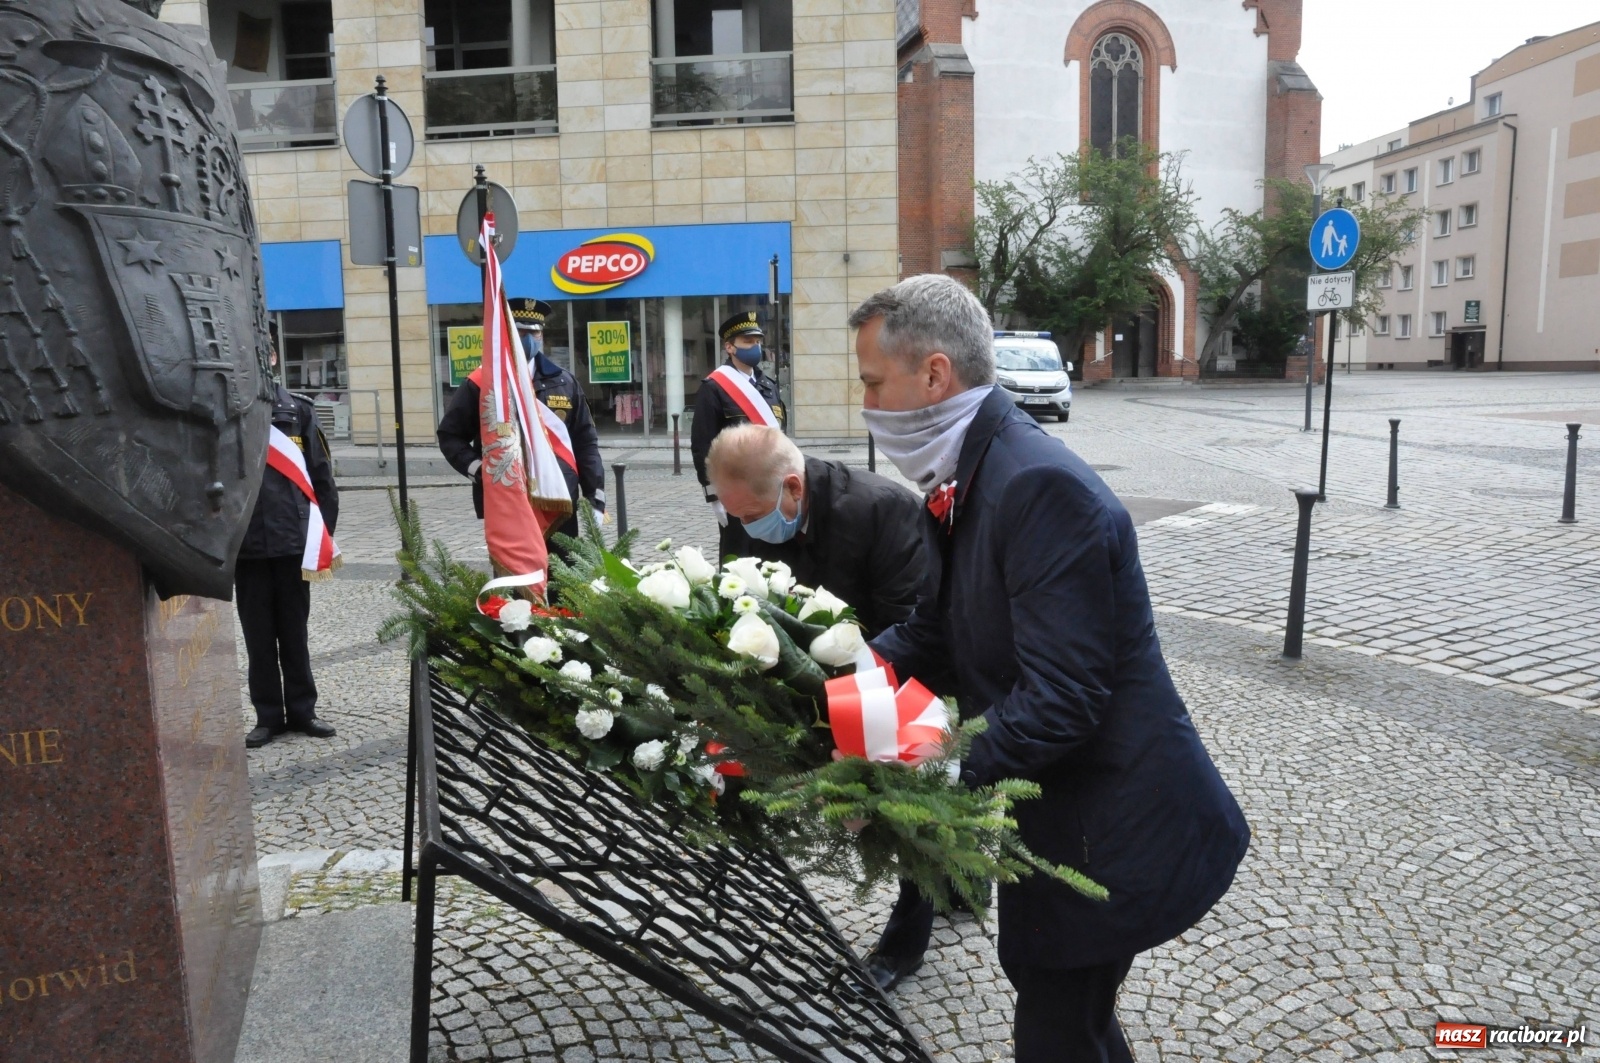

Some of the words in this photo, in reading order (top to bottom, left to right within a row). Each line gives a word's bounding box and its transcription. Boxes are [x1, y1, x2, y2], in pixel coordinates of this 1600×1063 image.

[567, 253, 638, 274] PEPCO
[1310, 277, 1322, 285] Nie
[1324, 275, 1352, 284] dotyczy
[450, 334, 483, 350] -30%
[590, 329, 626, 345] -30%
[454, 360, 465, 371] NA
[594, 356, 605, 367] NA
[606, 355, 626, 366] CAŁY
[0, 592, 94, 632] ONY
[0, 949, 138, 1005] orwid
